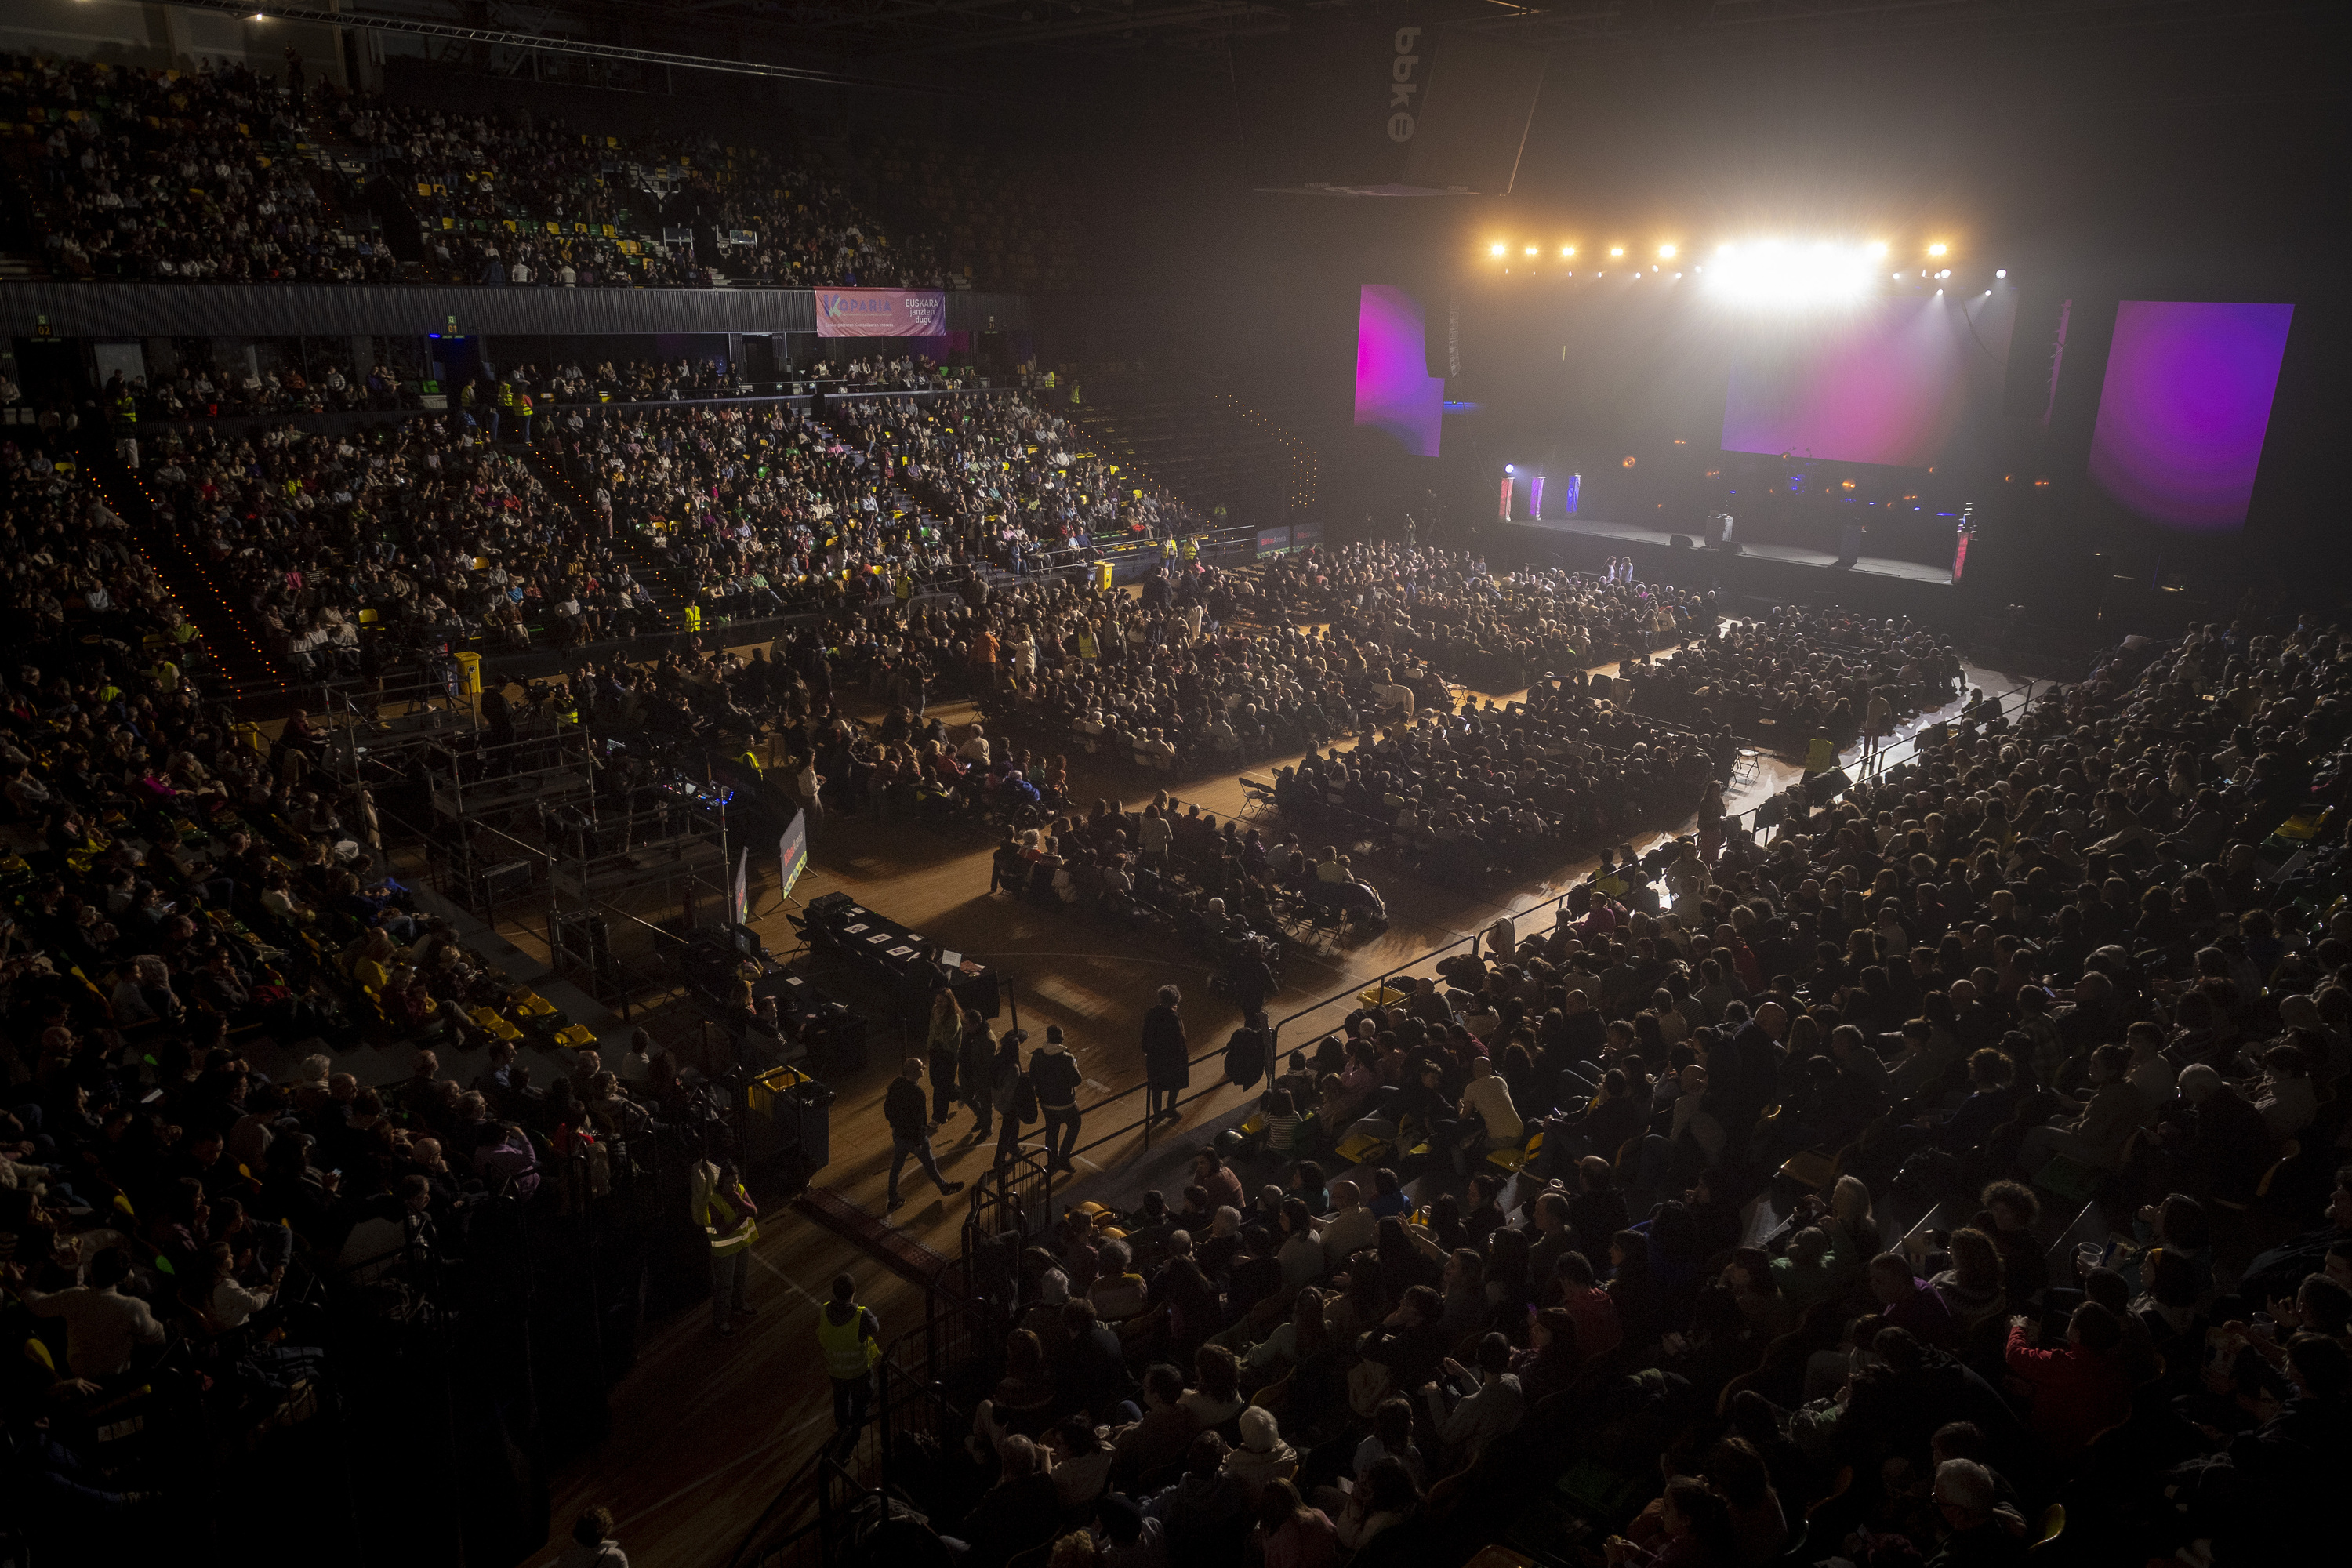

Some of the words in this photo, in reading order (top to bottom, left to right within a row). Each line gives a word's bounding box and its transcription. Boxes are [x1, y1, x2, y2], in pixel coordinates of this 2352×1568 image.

[910, 307, 935, 317] janzten
[915, 316, 932, 325] dugu
[38, 325, 51, 336] 02
[448, 325, 457, 333] 01
